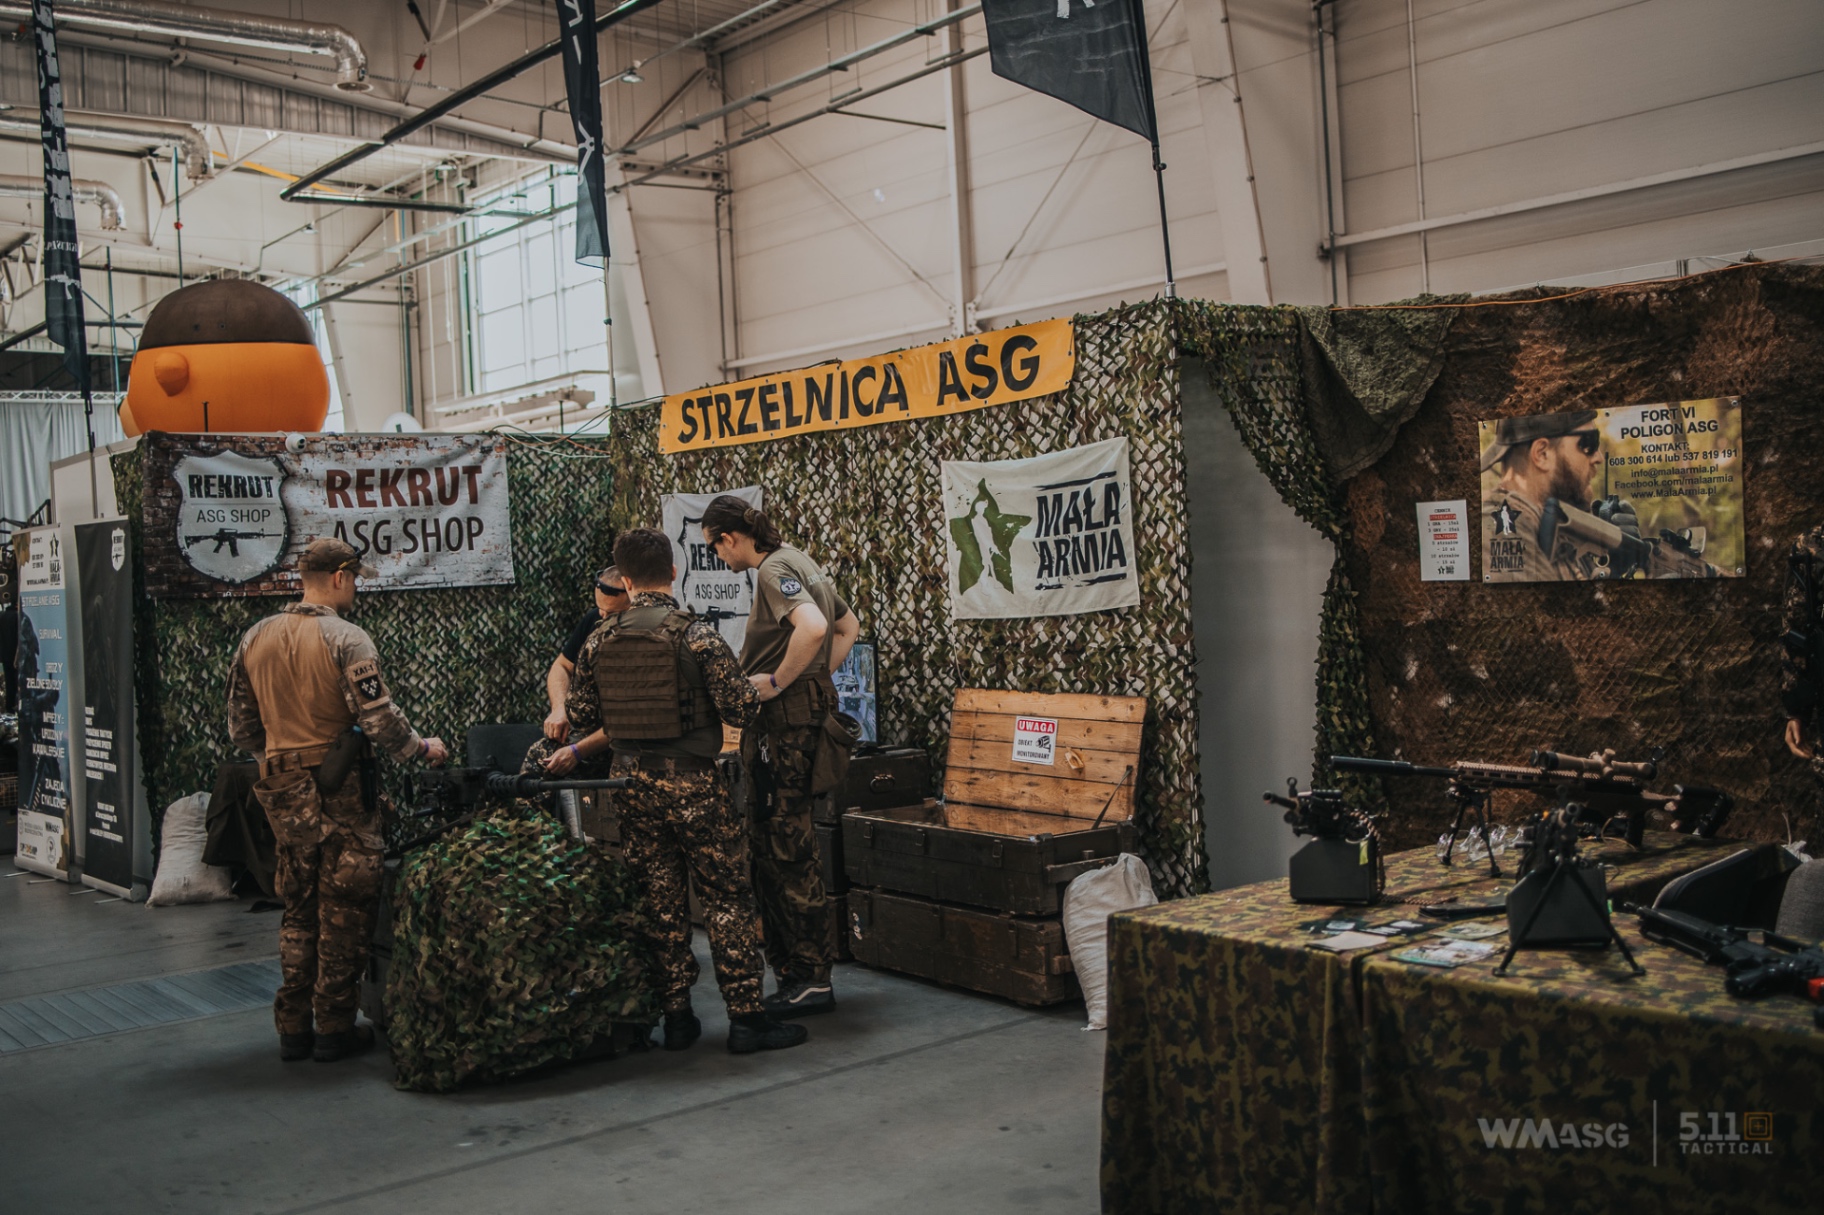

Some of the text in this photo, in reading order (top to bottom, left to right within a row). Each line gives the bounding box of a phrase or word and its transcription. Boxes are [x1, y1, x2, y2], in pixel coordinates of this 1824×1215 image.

[678, 334, 1041, 444] STRZELNICA ASG
[1641, 406, 1696, 422] FORT VI
[1620, 420, 1719, 440] POLIGON ASG
[1641, 442, 1690, 454] KONTAKT:
[1609, 449, 1738, 467] 608 300 614 lub 537 819 191
[1631, 464, 1719, 478] info@malaarmia.pl
[188, 474, 274, 499] REKRUT
[326, 465, 483, 508] REKRUT
[196, 508, 271, 523] ASG SHOP
[1035, 482, 1121, 538] MAŁA
[333, 516, 484, 556] ASG SHOP
[1036, 528, 1127, 579] ARMIA
[1490, 541, 1523, 556] MAŁA
[1490, 556, 1525, 569] ARMIA
[695, 584, 740, 599] ASG SHOP
[1019, 720, 1053, 732] UWAGA
